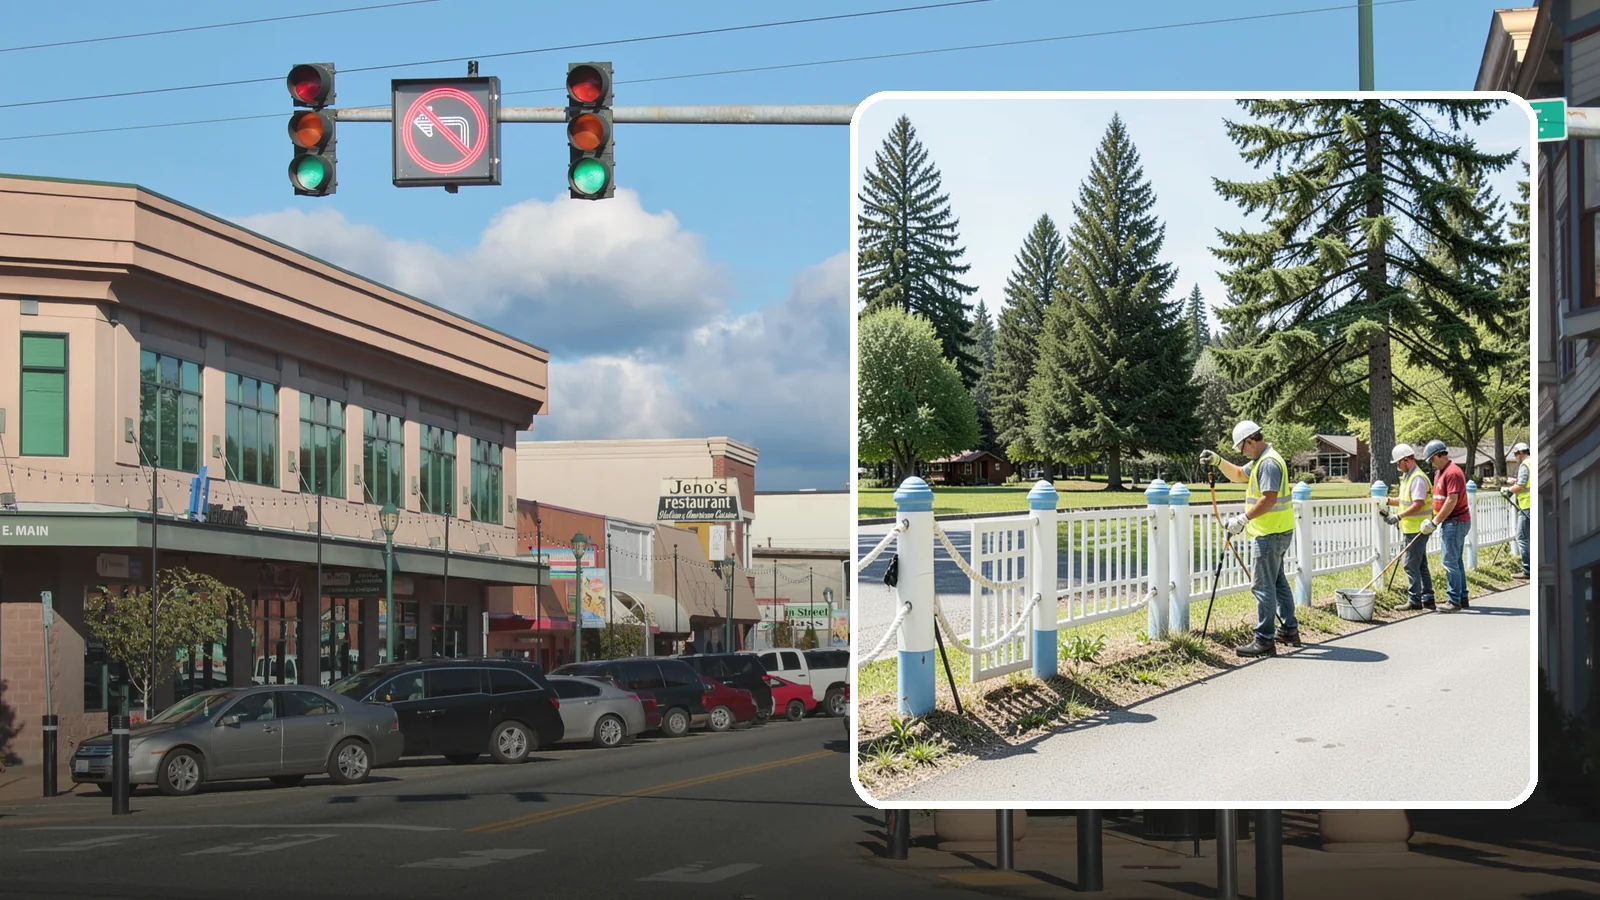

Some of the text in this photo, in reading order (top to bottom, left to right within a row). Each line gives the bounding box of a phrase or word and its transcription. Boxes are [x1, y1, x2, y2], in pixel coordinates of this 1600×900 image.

[669, 480, 727, 494] Jeno's
[665, 497, 731, 509] restaurant
[658, 510, 681, 519] Italian
[686, 510, 714, 519] American
[715, 509, 737, 519] Cuisine
[2, 525, 49, 536] E. MAIN
[786, 607, 828, 617] in Street
[791, 619, 823, 627] lass
